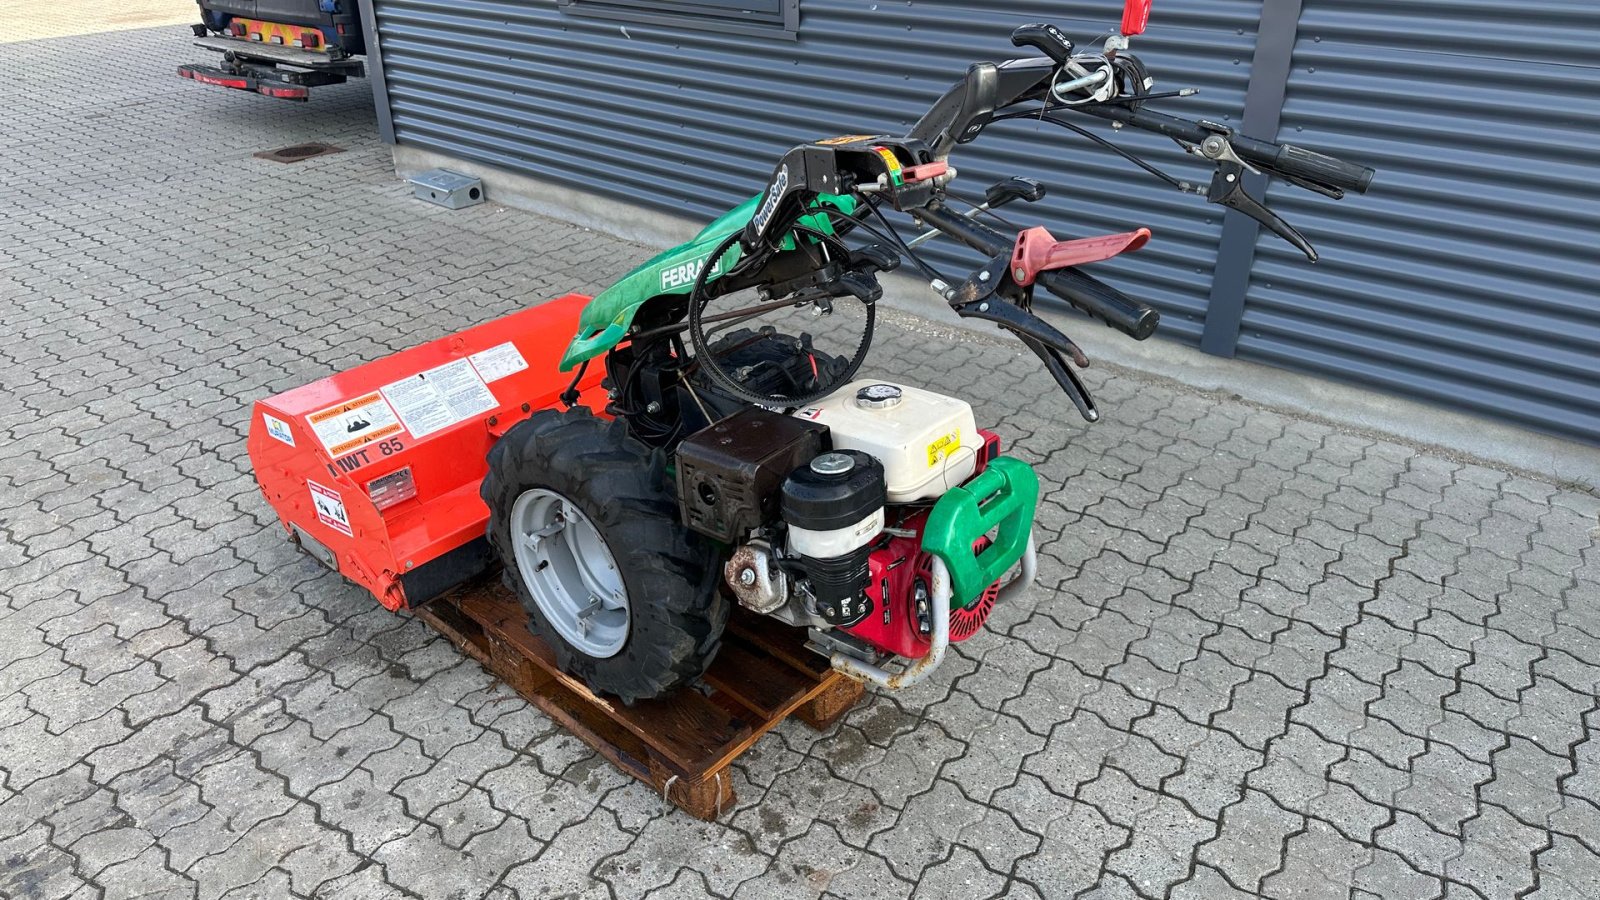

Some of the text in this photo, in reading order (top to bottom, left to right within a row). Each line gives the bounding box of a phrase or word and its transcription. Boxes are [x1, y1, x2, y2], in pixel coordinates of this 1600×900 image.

[754, 173, 787, 234] PowerSafe
[661, 256, 720, 290] FERRAI
[314, 394, 379, 421] WARNING ATTENTION
[379, 437, 404, 456] 85
